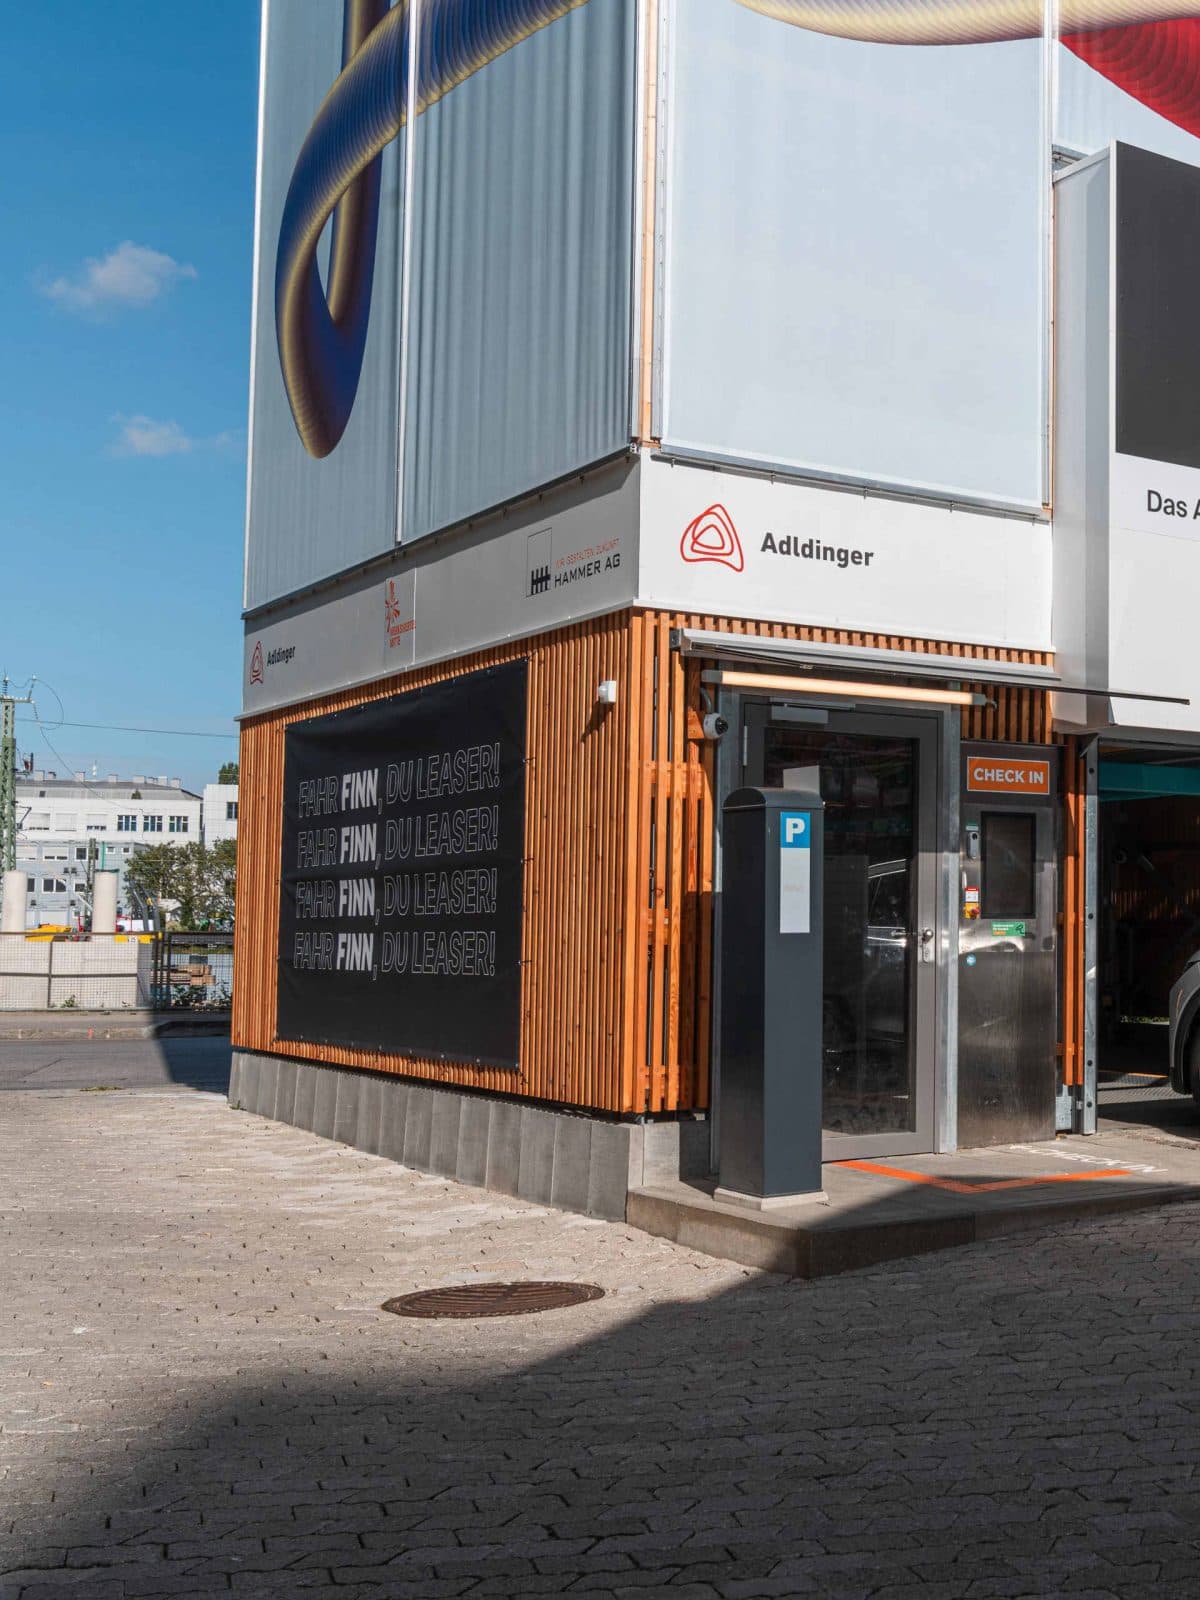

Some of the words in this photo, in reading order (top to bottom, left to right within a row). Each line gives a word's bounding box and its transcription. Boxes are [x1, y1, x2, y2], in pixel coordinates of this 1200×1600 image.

[1147, 489, 1188, 518] Das
[760, 532, 874, 568] Adldinger
[554, 560, 601, 588] HAMMER
[604, 553, 621, 571] AG
[299, 775, 338, 818] FAHR
[341, 768, 382, 815] FINN,
[386, 760, 414, 805] DU
[416, 742, 500, 800] LEASER!
[974, 767, 1025, 784] CHECK
[1028, 770, 1044, 785] IN
[297, 827, 336, 868] FAHR
[340, 823, 381, 870] FINN,
[385, 817, 412, 860] DU
[415, 805, 499, 857] LEASER!
[786, 817, 805, 843] P
[296, 880, 335, 918] FAHR
[339, 877, 380, 925] FINN,
[384, 874, 409, 916] DU
[413, 868, 497, 915] LEASER!
[293, 932, 334, 970] FAHR
[336, 932, 377, 980] FINN,
[381, 931, 408, 973] DU
[411, 931, 496, 976] LEASER!
